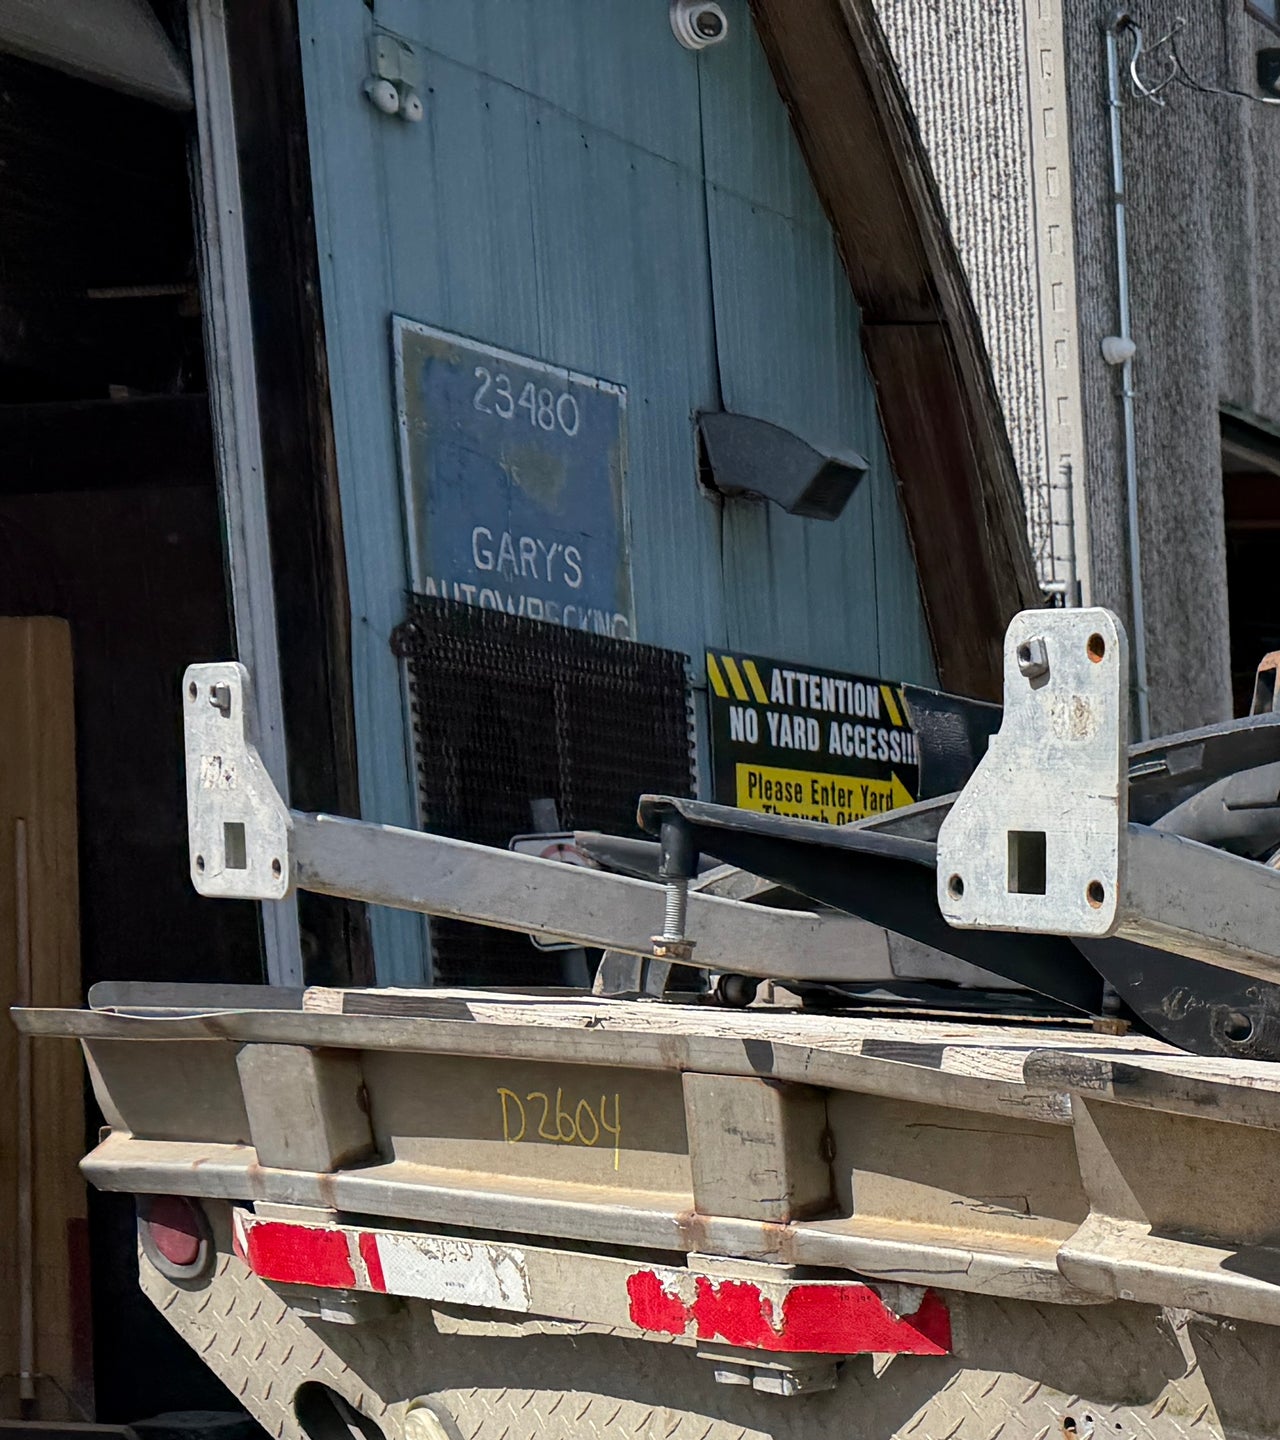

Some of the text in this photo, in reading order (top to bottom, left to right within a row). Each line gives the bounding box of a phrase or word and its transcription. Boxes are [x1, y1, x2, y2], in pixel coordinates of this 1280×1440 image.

[472, 365, 581, 437] 23480
[471, 525, 583, 590] GARY'S
[770, 667, 881, 720] ATTENTION
[729, 705, 919, 766] NO YARD ACCESS!!!
[747, 771, 895, 812] Please Enter Yard
[497, 1086, 621, 1172] D2604
